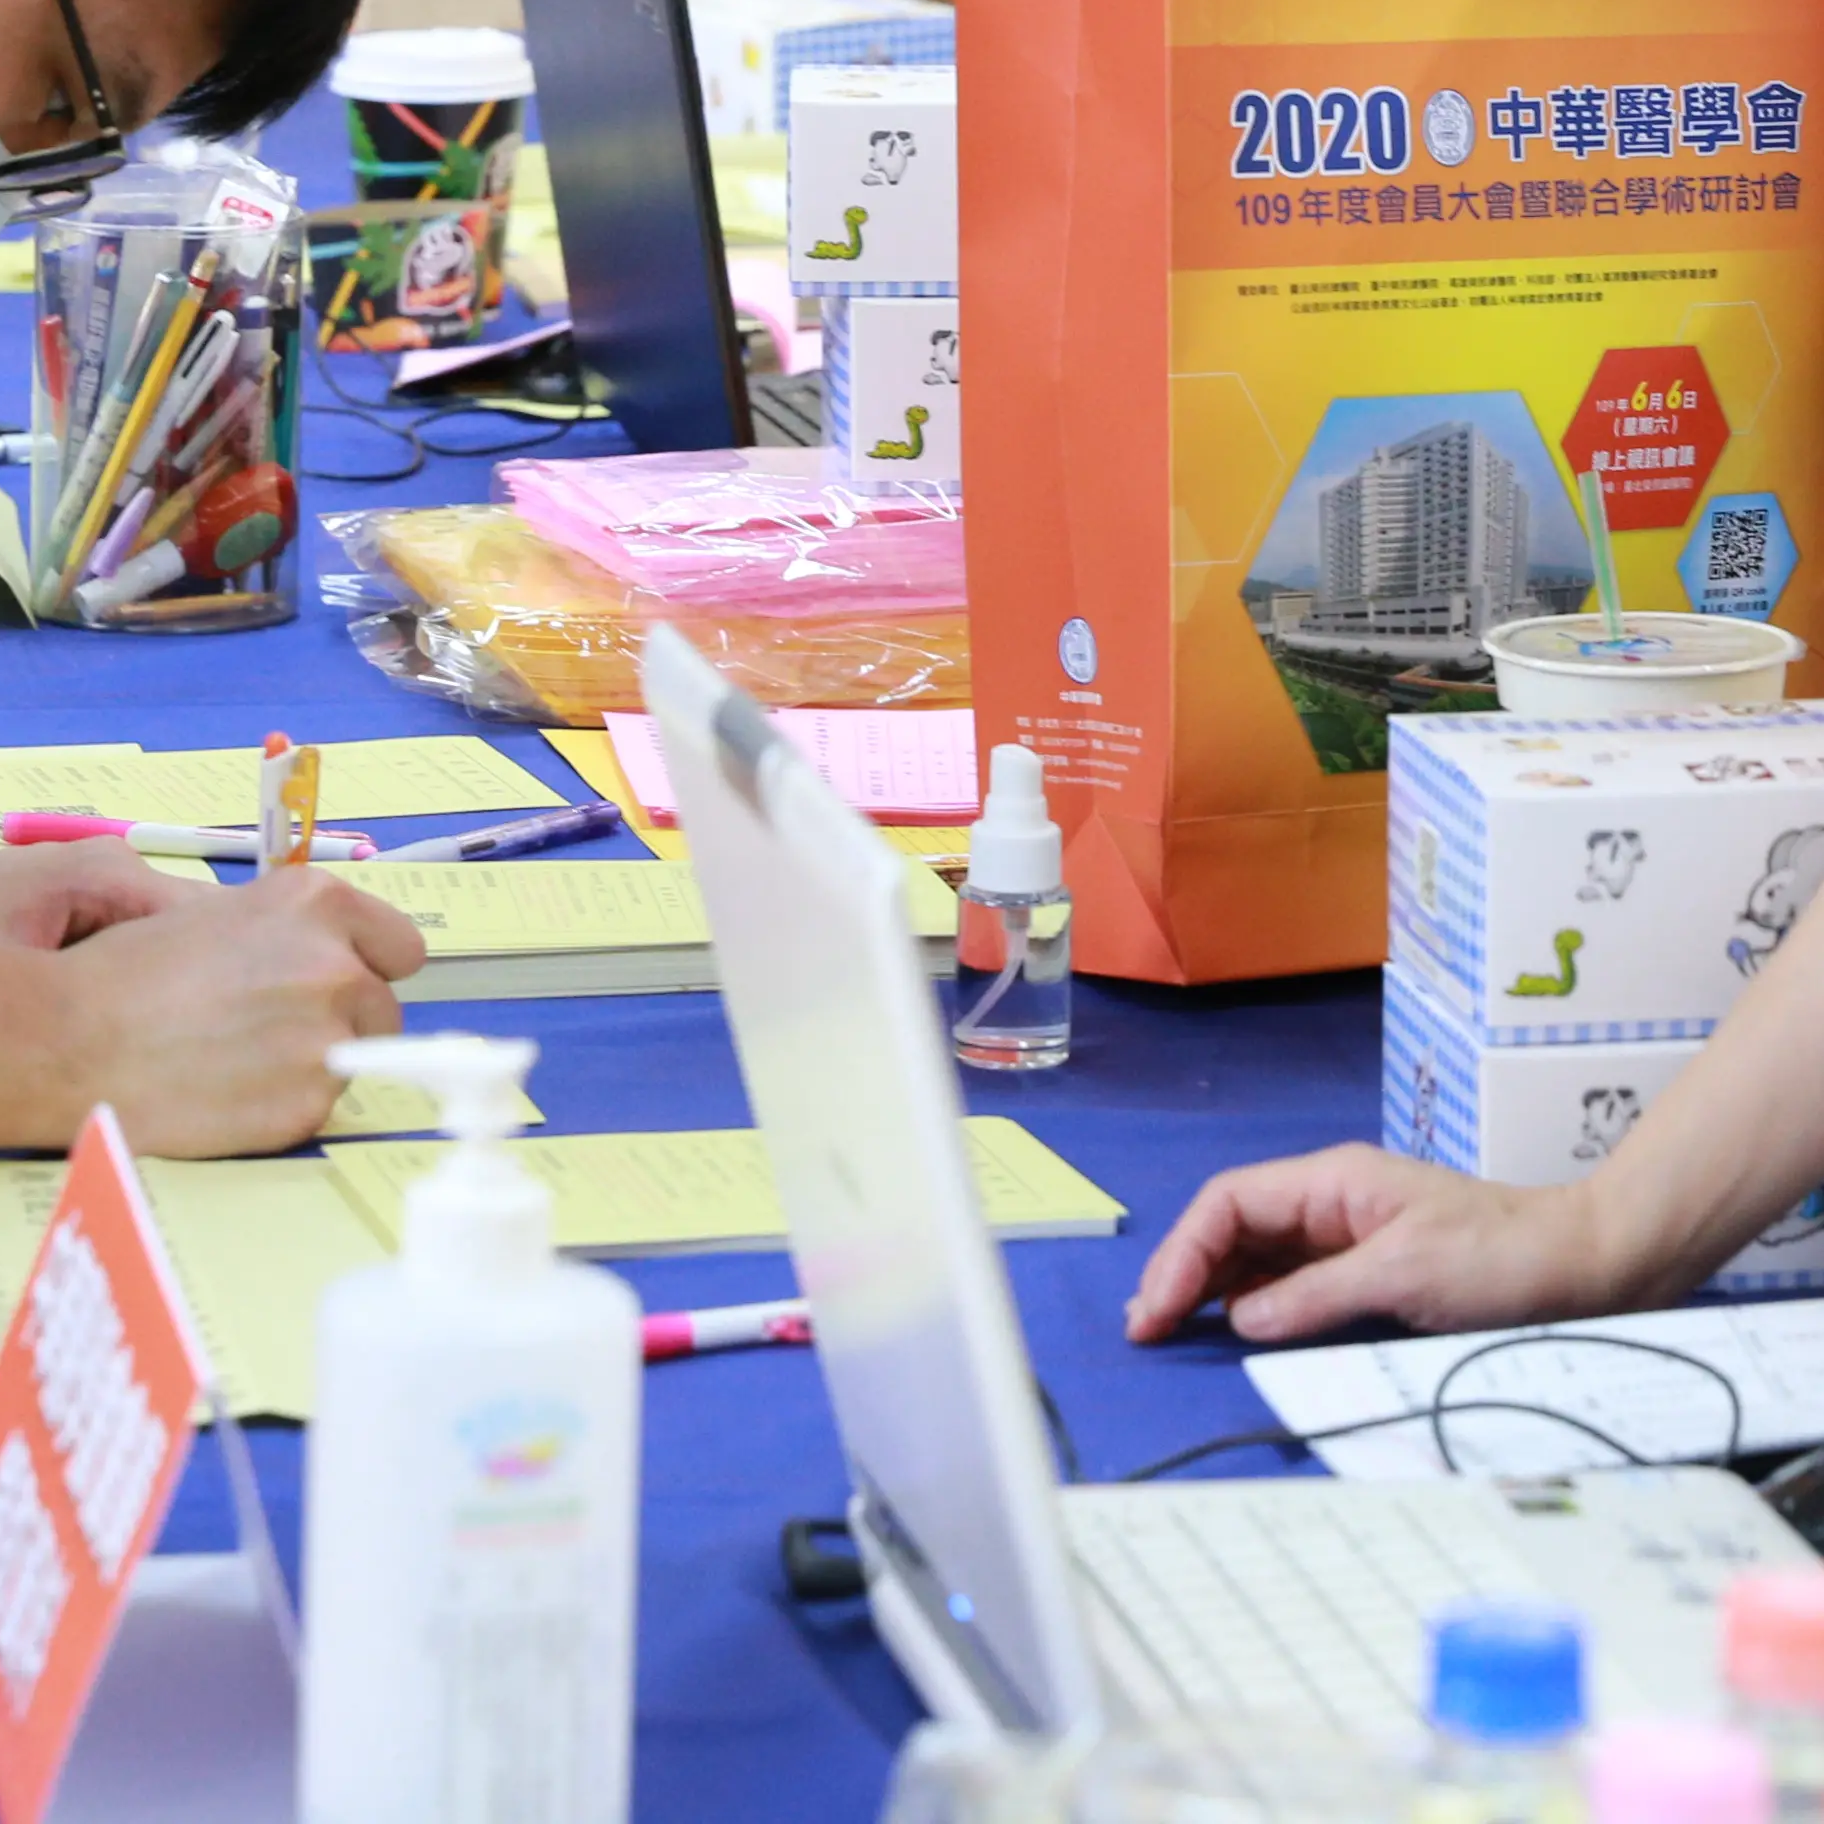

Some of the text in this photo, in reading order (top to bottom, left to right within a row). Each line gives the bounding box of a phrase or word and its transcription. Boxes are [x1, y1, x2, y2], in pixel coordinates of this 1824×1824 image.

[1233, 82, 1805, 177] 2020 中華醫學會
